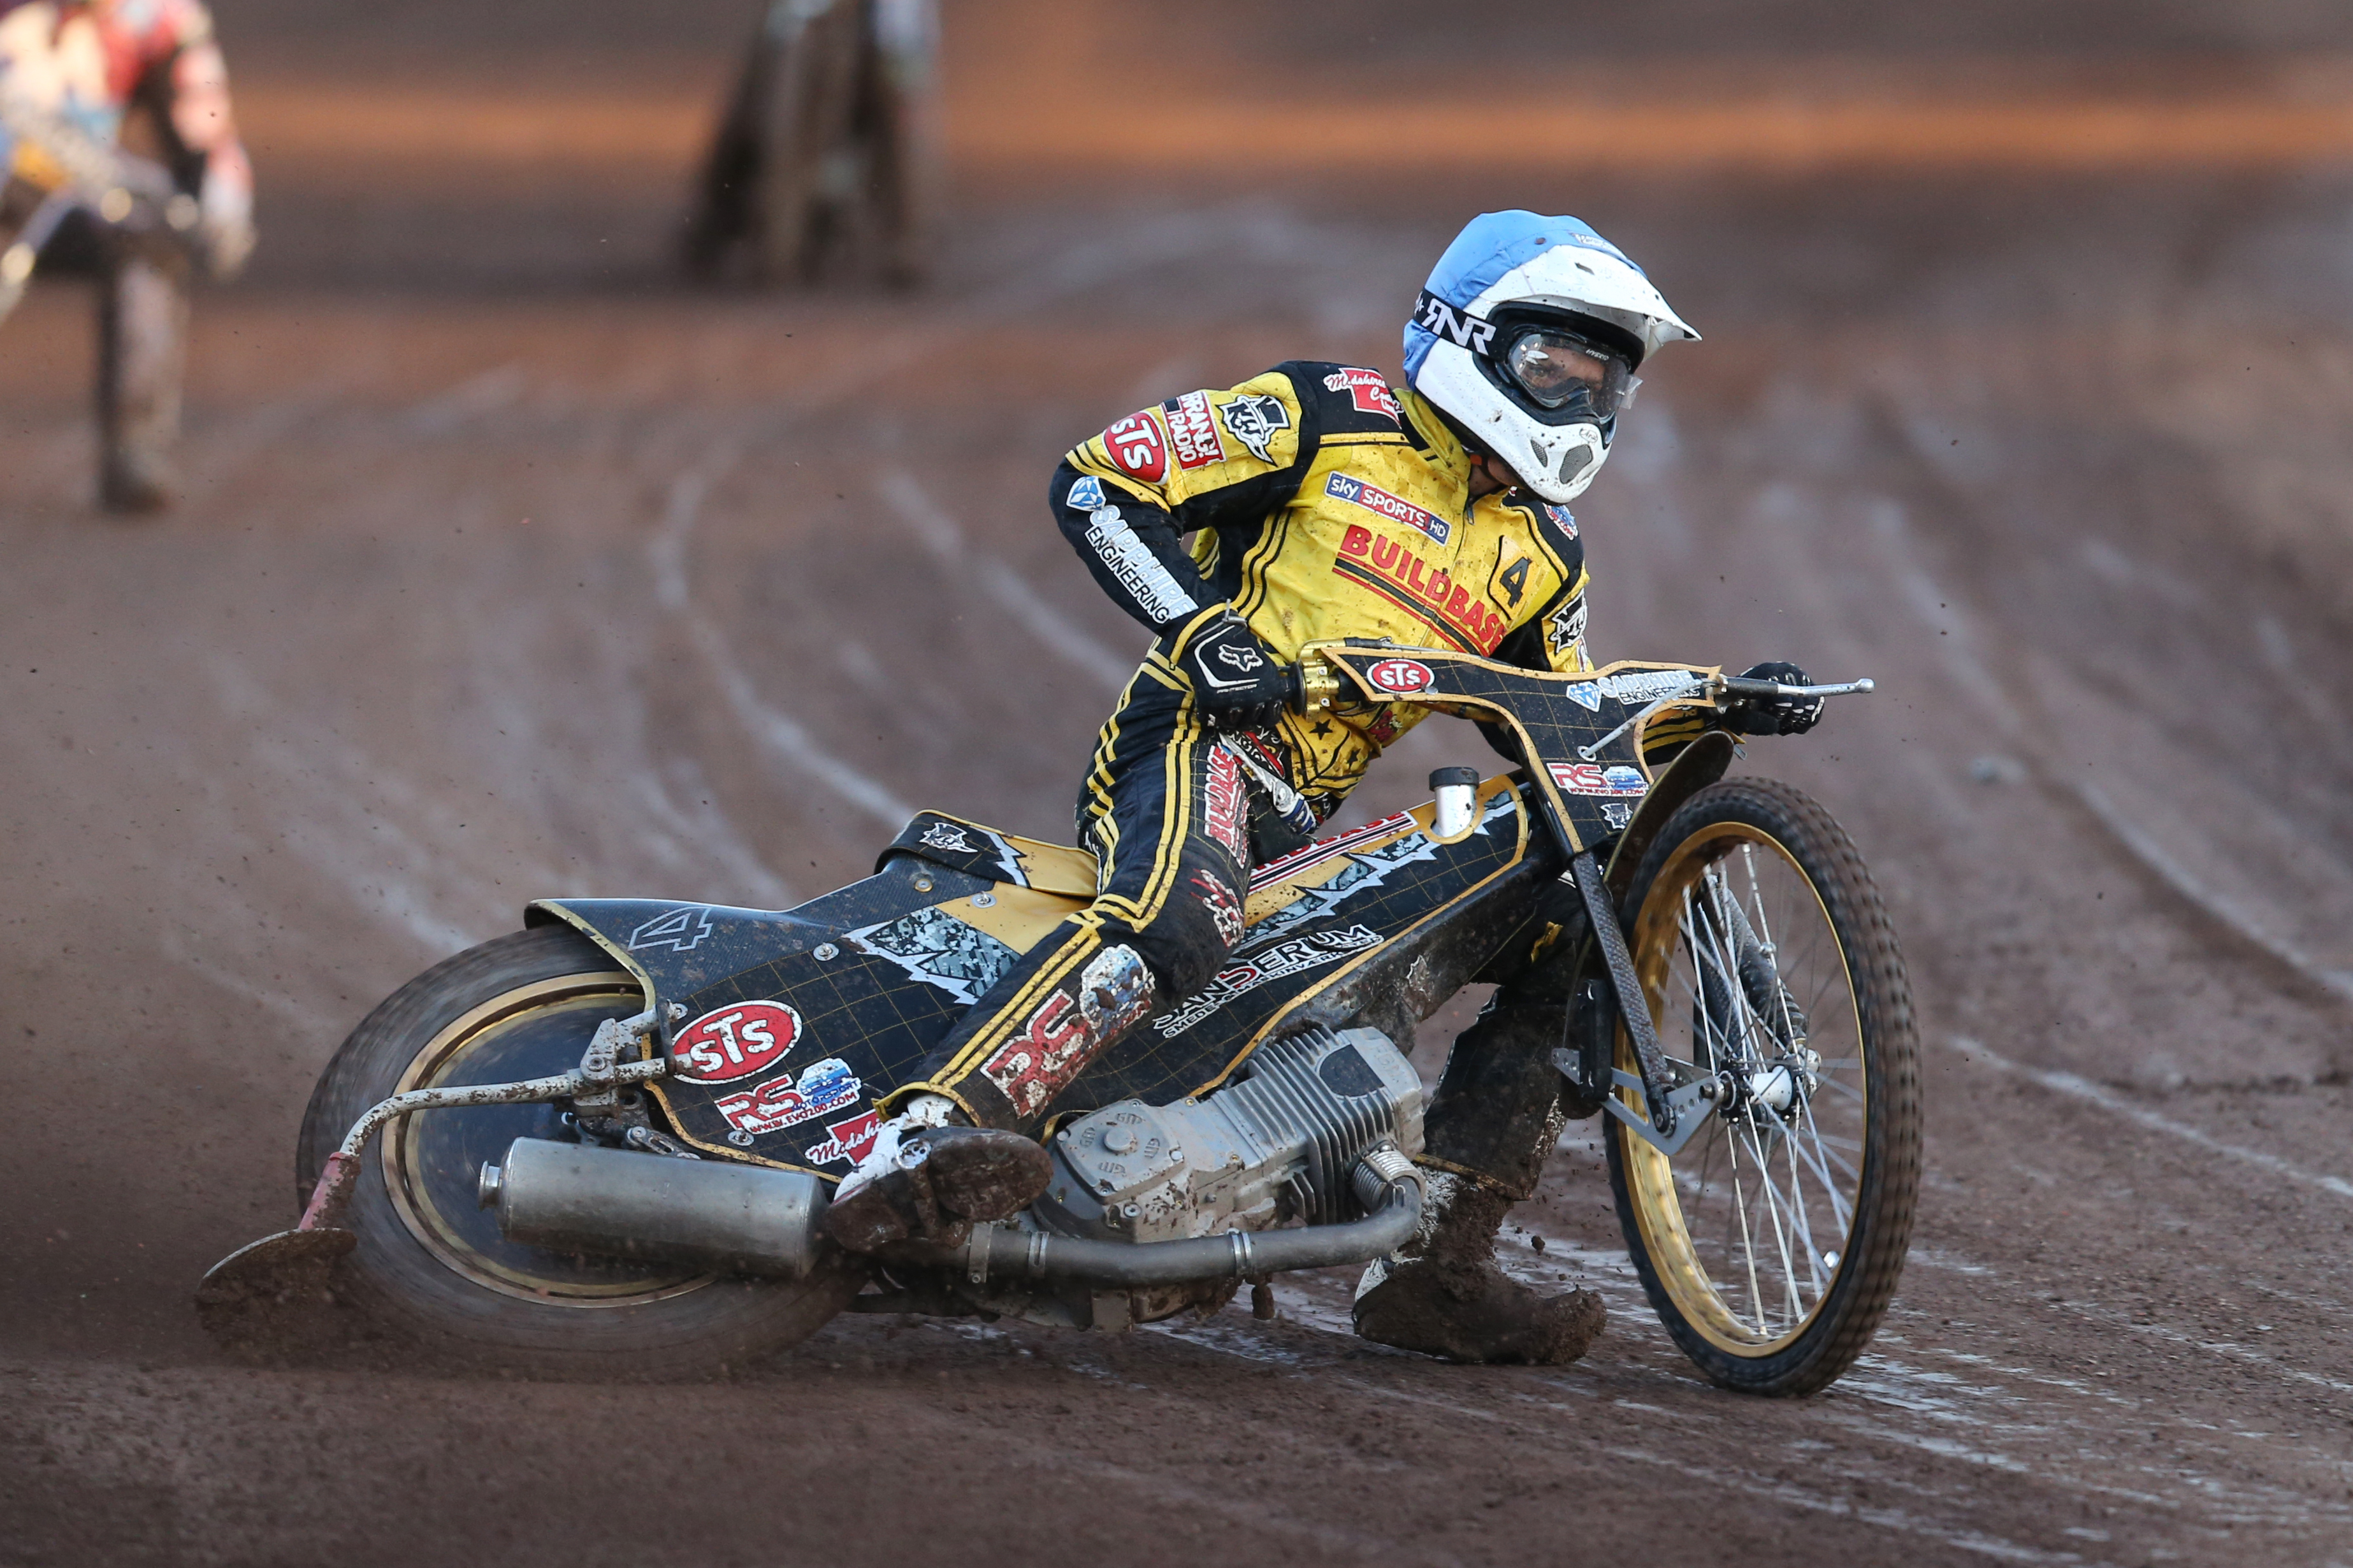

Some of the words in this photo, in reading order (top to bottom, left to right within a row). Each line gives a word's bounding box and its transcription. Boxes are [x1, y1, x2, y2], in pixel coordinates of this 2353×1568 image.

[1168, 413, 1197, 463] RADIO
[1330, 478, 1359, 499] sky
[1362, 488, 1426, 528] SPORTS
[1429, 520, 1446, 538] HD
[1088, 526, 1169, 622] ENGINEERING
[1090, 505, 1199, 620] SAPPHIRE
[1500, 556, 1532, 608] 4
[1597, 670, 1695, 698] SAPPHIRE
[1550, 765, 1608, 788] RS
[628, 907, 714, 952] 4
[718, 1077, 803, 1128] RS
[809, 1118, 883, 1163] Midshi
